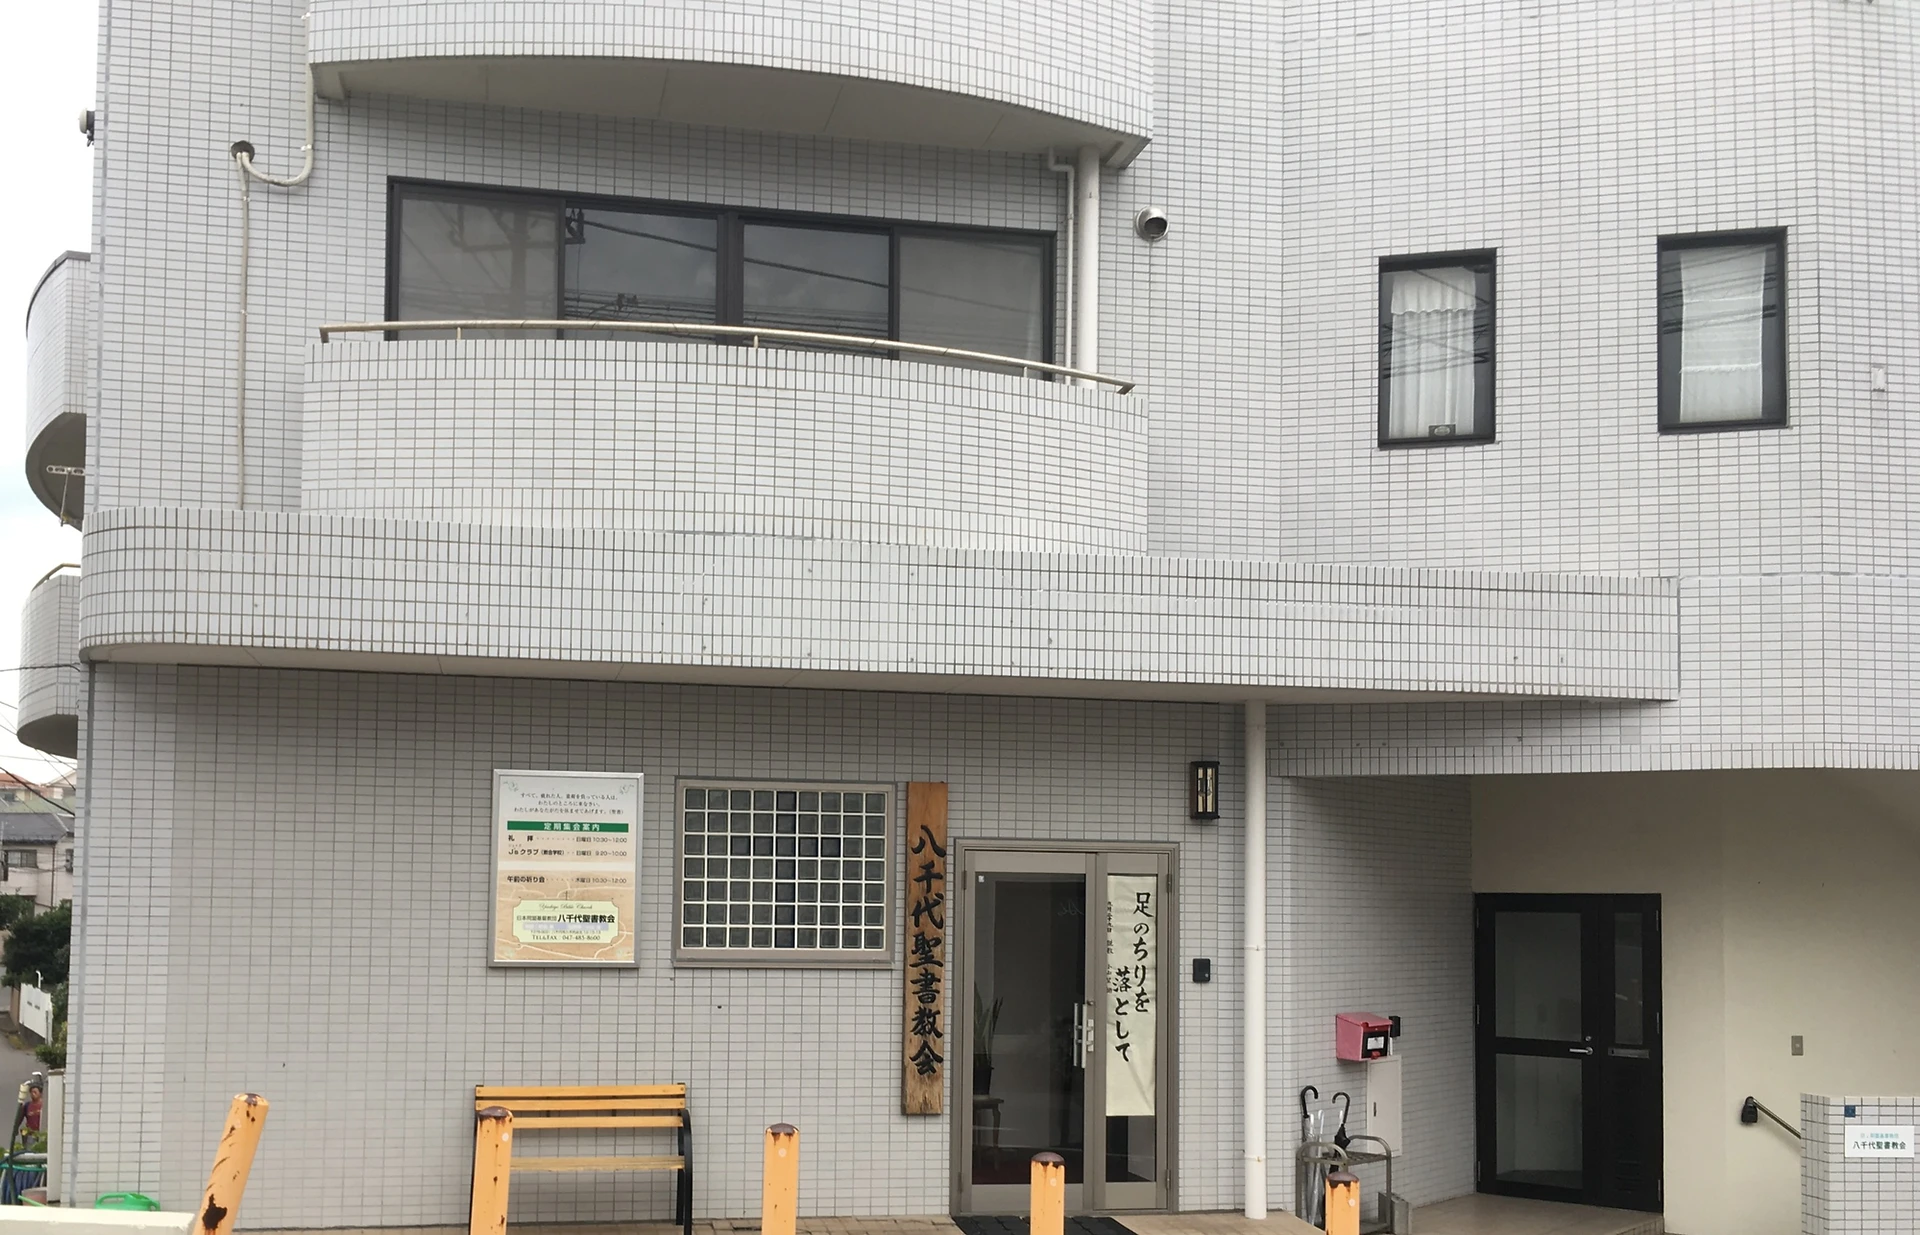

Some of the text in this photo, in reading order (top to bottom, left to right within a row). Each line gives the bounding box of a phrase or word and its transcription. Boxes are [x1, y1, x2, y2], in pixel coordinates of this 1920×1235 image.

[543, 822, 600, 831] 定期集会案内
[507, 875, 545, 883] 午前の祈り会
[557, 914, 615, 923] 八千代聖書教会
[909, 824, 947, 1076] 八千代聖書教会
[1132, 891, 1154, 1013] 足のちりを
[1113, 967, 1132, 1062] 落として
[1852, 1141, 1906, 1150] 八千代聖書教会
